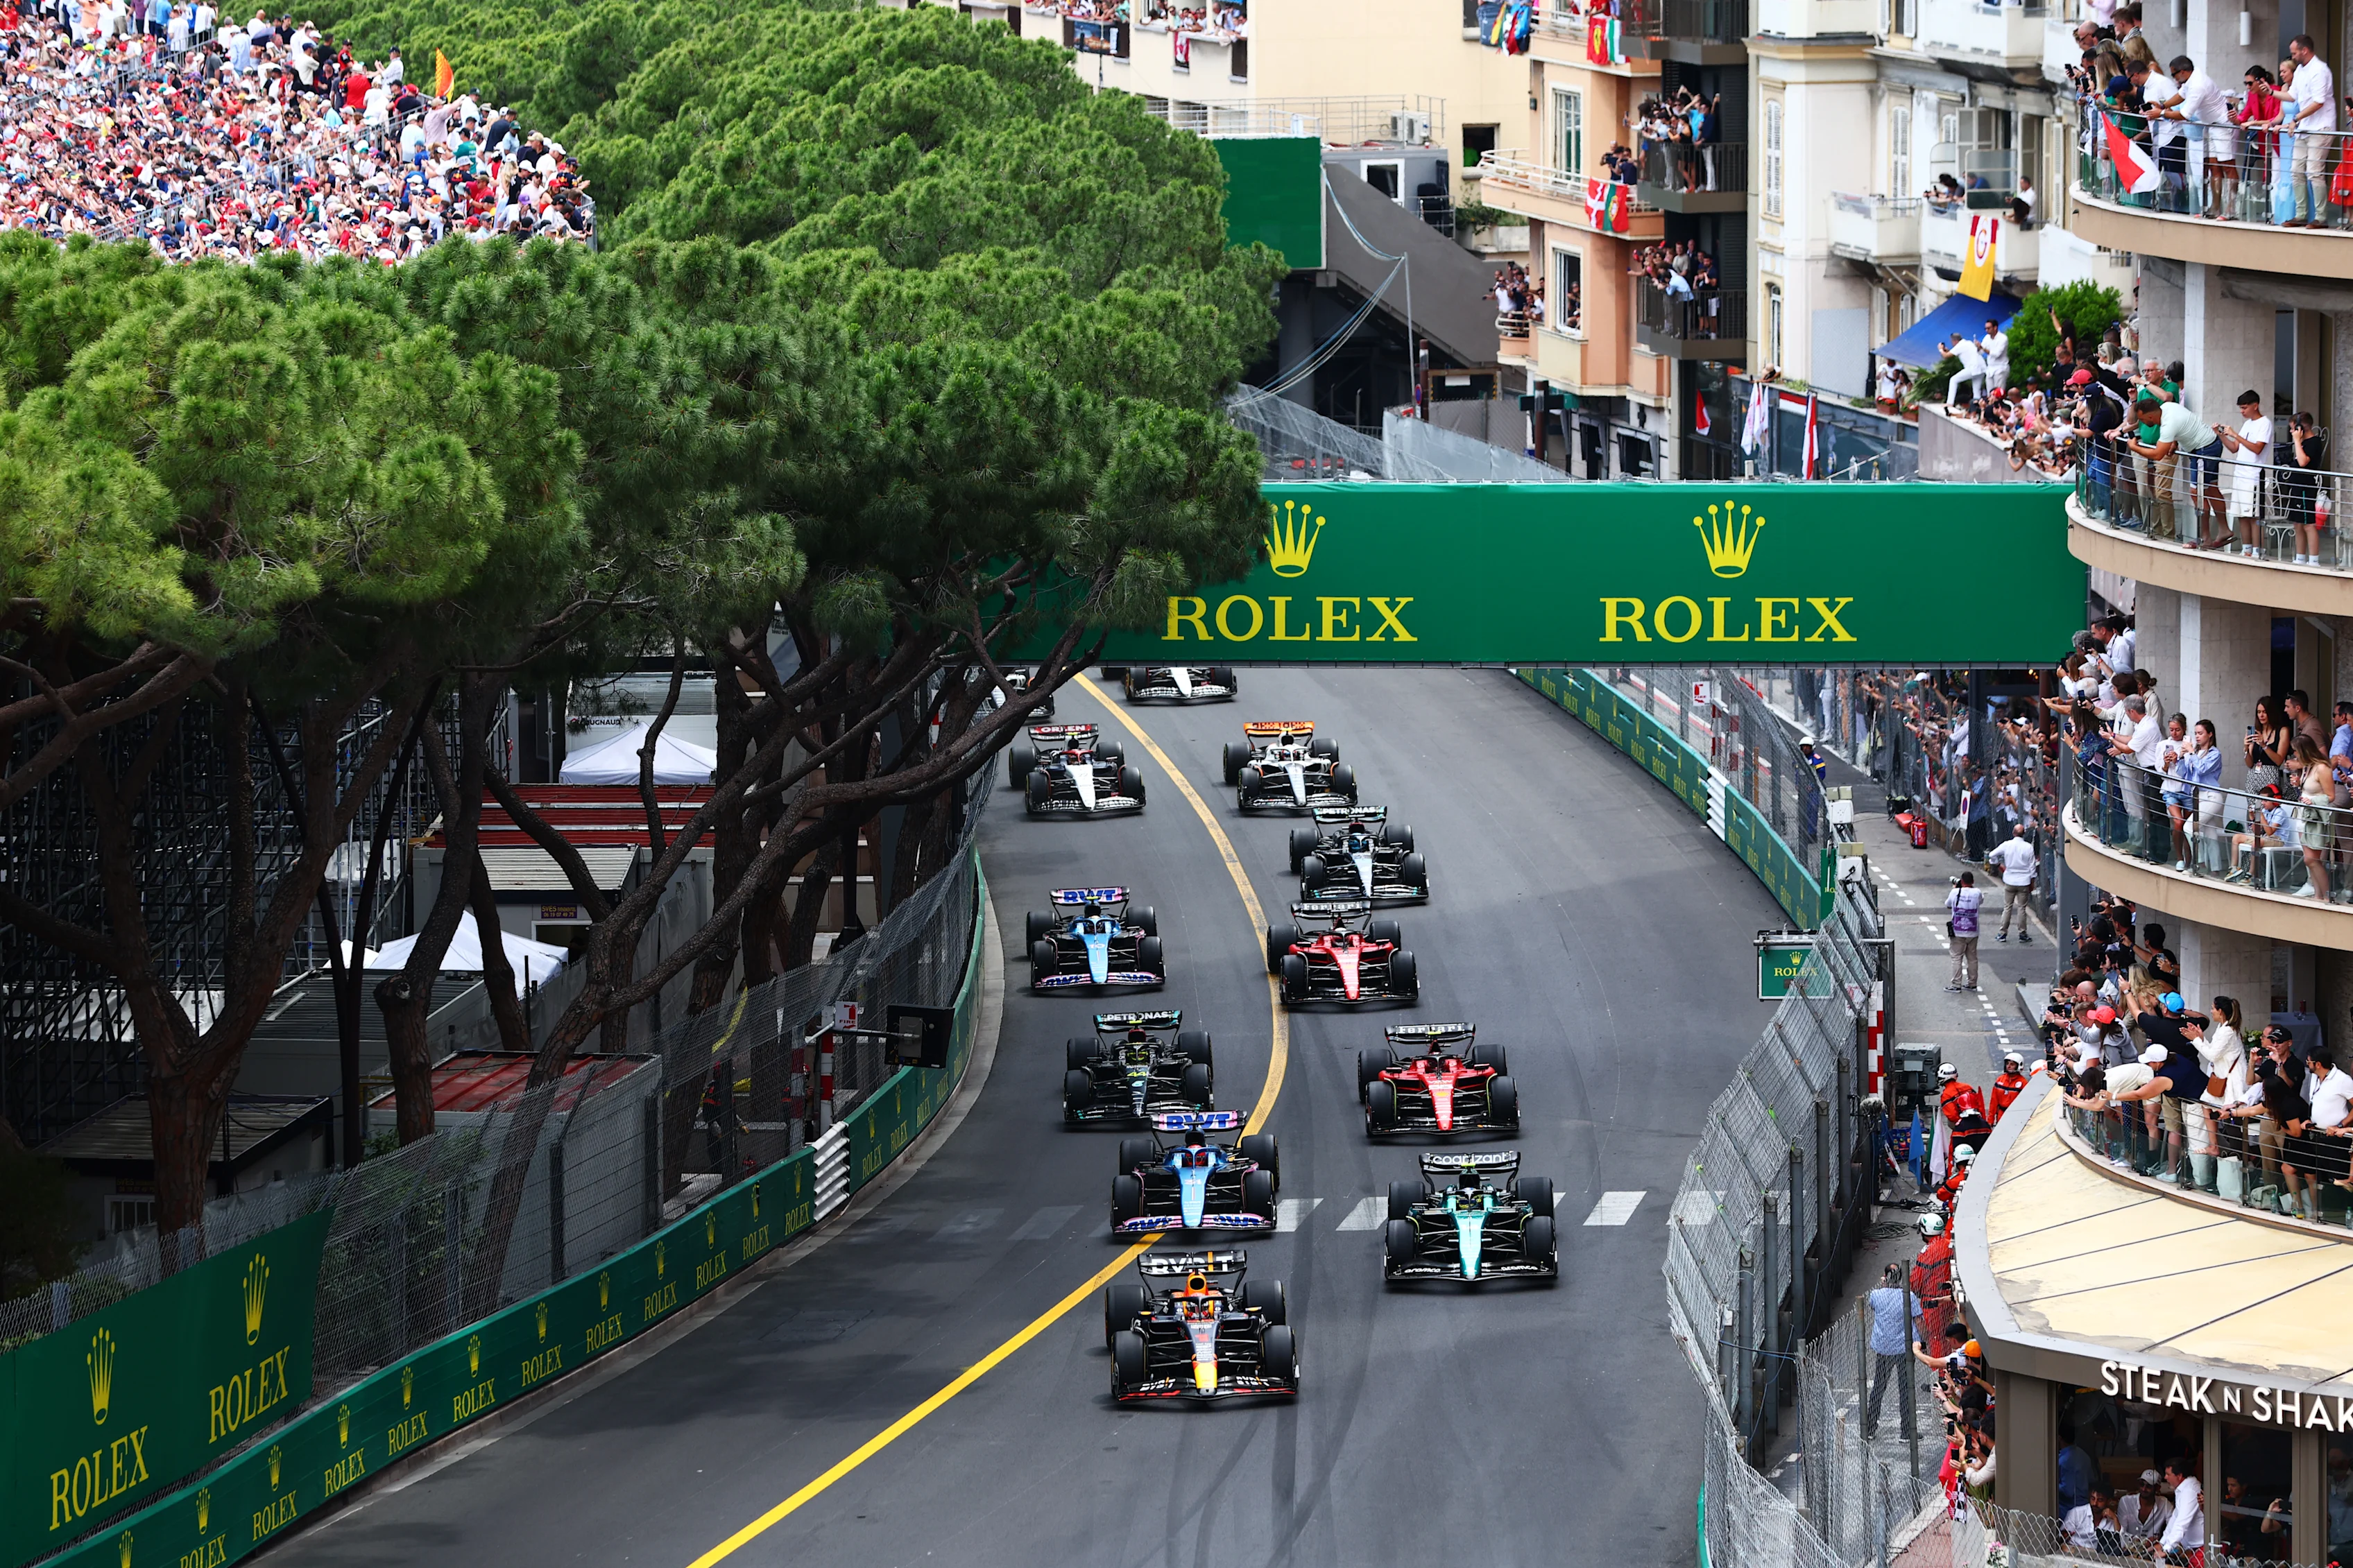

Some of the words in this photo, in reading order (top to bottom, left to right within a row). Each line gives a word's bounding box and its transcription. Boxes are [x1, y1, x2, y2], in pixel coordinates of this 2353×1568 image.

[1161, 594, 1418, 642] ROLEX
[1599, 595, 1858, 643] ROLEX
[1322, 807, 1376, 815] PETRONAS
[1774, 967, 1819, 976] ROLEX
[1106, 1012, 1170, 1021] PETRONAS
[916, 1096, 930, 1128] ROLEX
[1166, 1114, 1230, 1130] BWT
[890, 1120, 908, 1154] ROLEX
[862, 1144, 882, 1180] ROLEX
[1432, 1152, 1509, 1169] cognizant
[785, 1200, 810, 1236] ROLEX
[742, 1224, 769, 1260] ROLEX
[696, 1250, 726, 1290] ROLEX
[644, 1280, 677, 1321] ROLEX
[585, 1312, 623, 1354] ROLEX
[521, 1344, 563, 1387] ROLEX
[209, 1345, 290, 1445] ROLEX
[453, 1377, 496, 1422] ROLEX
[2100, 1360, 2217, 1415] STEAK
[2223, 1385, 2243, 1413] N
[2251, 1386, 2353, 1433] SHAK
[388, 1410, 428, 1456] ROLEX
[49, 1424, 149, 1531] ROLEX
[324, 1447, 366, 1497] ROLEX
[253, 1490, 298, 1541] ROLEX
